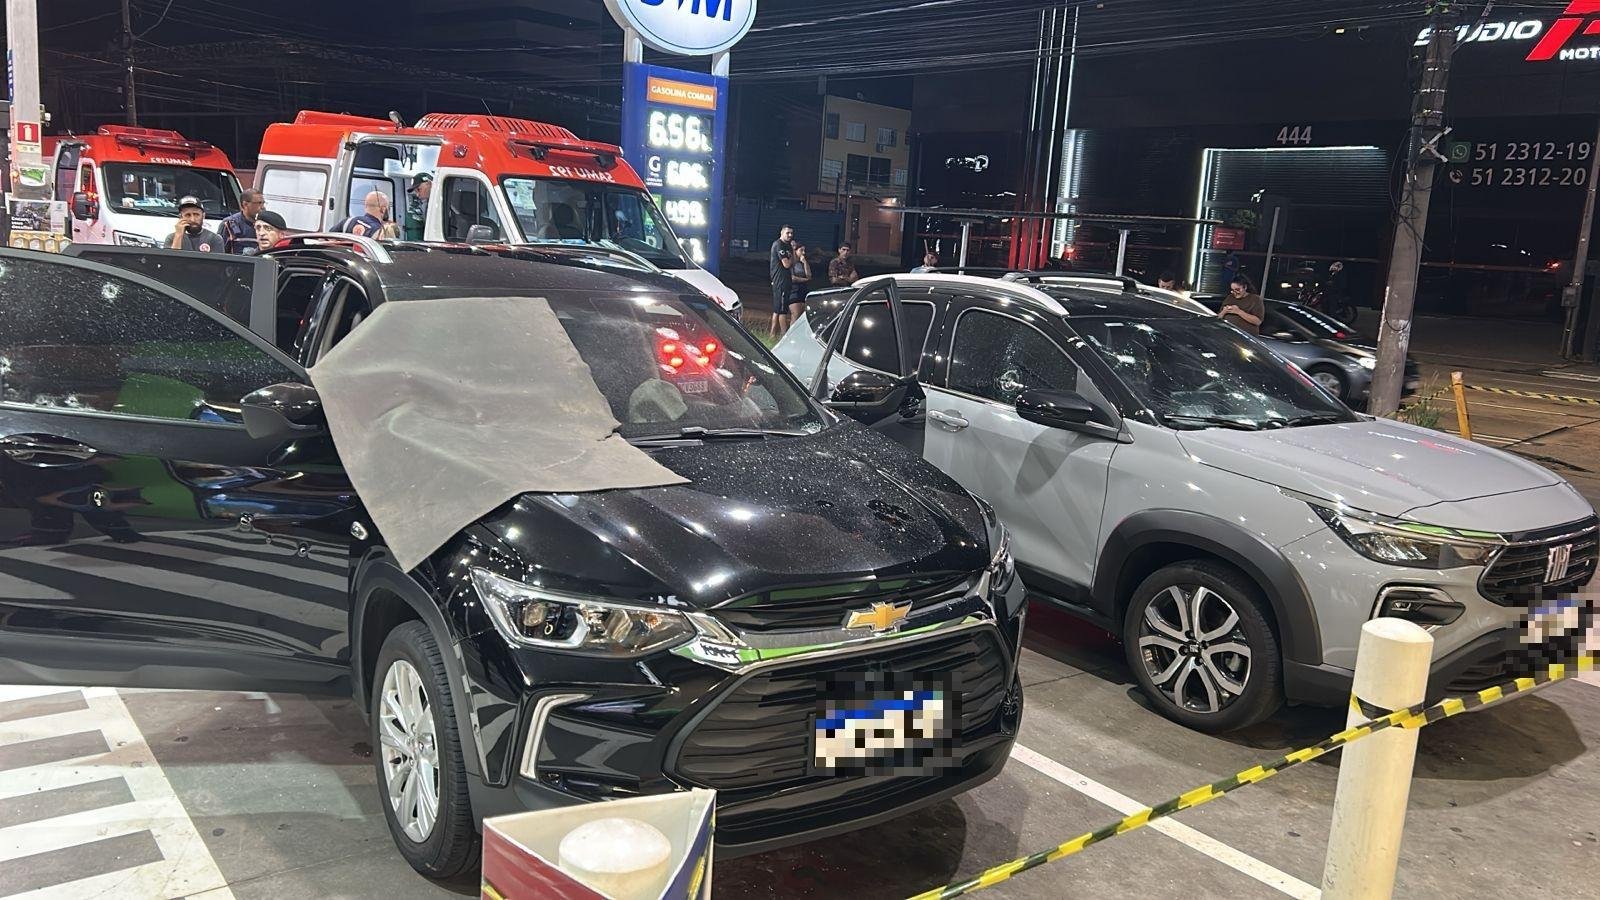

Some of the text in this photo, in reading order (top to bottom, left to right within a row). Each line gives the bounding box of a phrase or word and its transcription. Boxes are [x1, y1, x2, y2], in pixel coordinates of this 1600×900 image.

[1414, 20, 1543, 47] SUDIO
[1559, 46, 1600, 61] MOT
[651, 85, 713, 102] GASOLINA COMUM
[1277, 126, 1312, 145] 444
[1475, 142, 1595, 160] 51 2312-19
[649, 155, 661, 172] G
[1471, 168, 1586, 186] 51 2312-20
